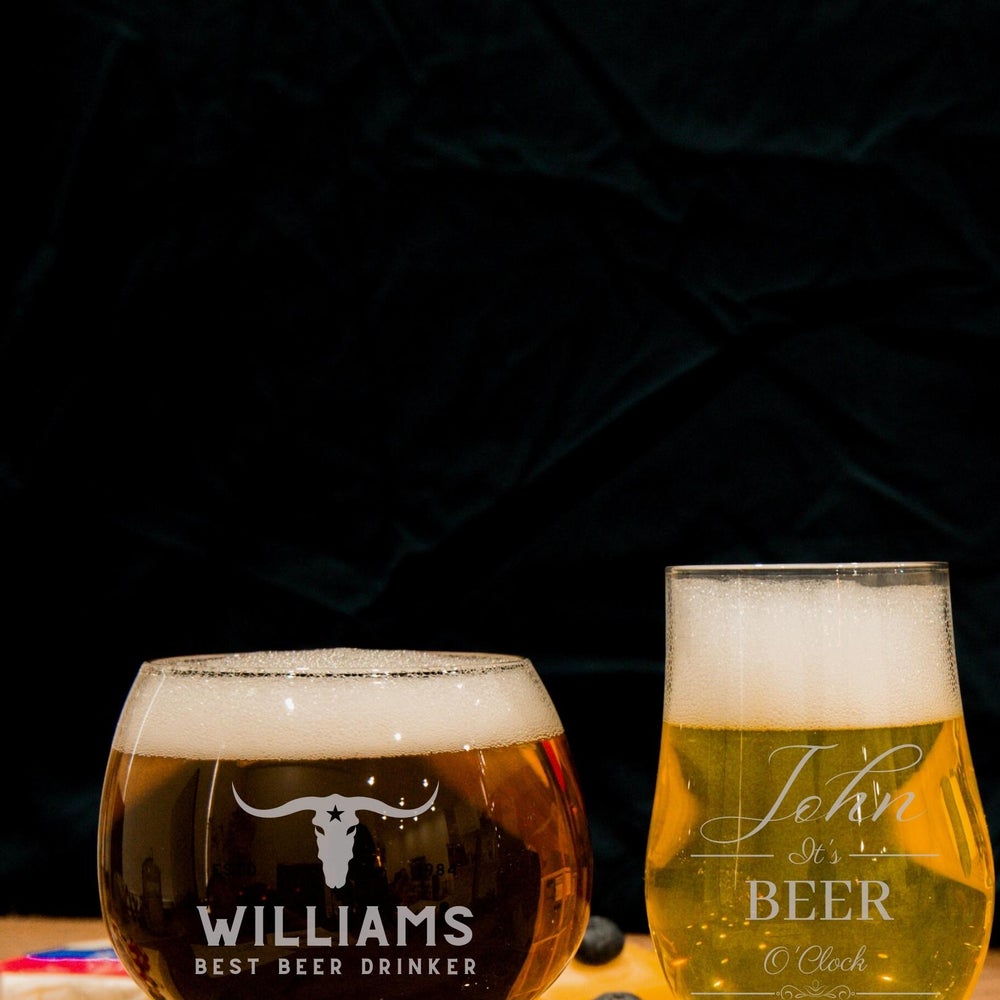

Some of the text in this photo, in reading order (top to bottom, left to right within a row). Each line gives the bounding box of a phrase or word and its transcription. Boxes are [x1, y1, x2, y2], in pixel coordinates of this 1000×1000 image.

[699, 743, 928, 845] John
[788, 836, 842, 865] It's
[745, 880, 895, 921] BEER
[196, 905, 474, 948] WILLIAMS
[194, 957, 477, 976] BEST BEER DRINKER
[763, 944, 868, 976] O'Clock
